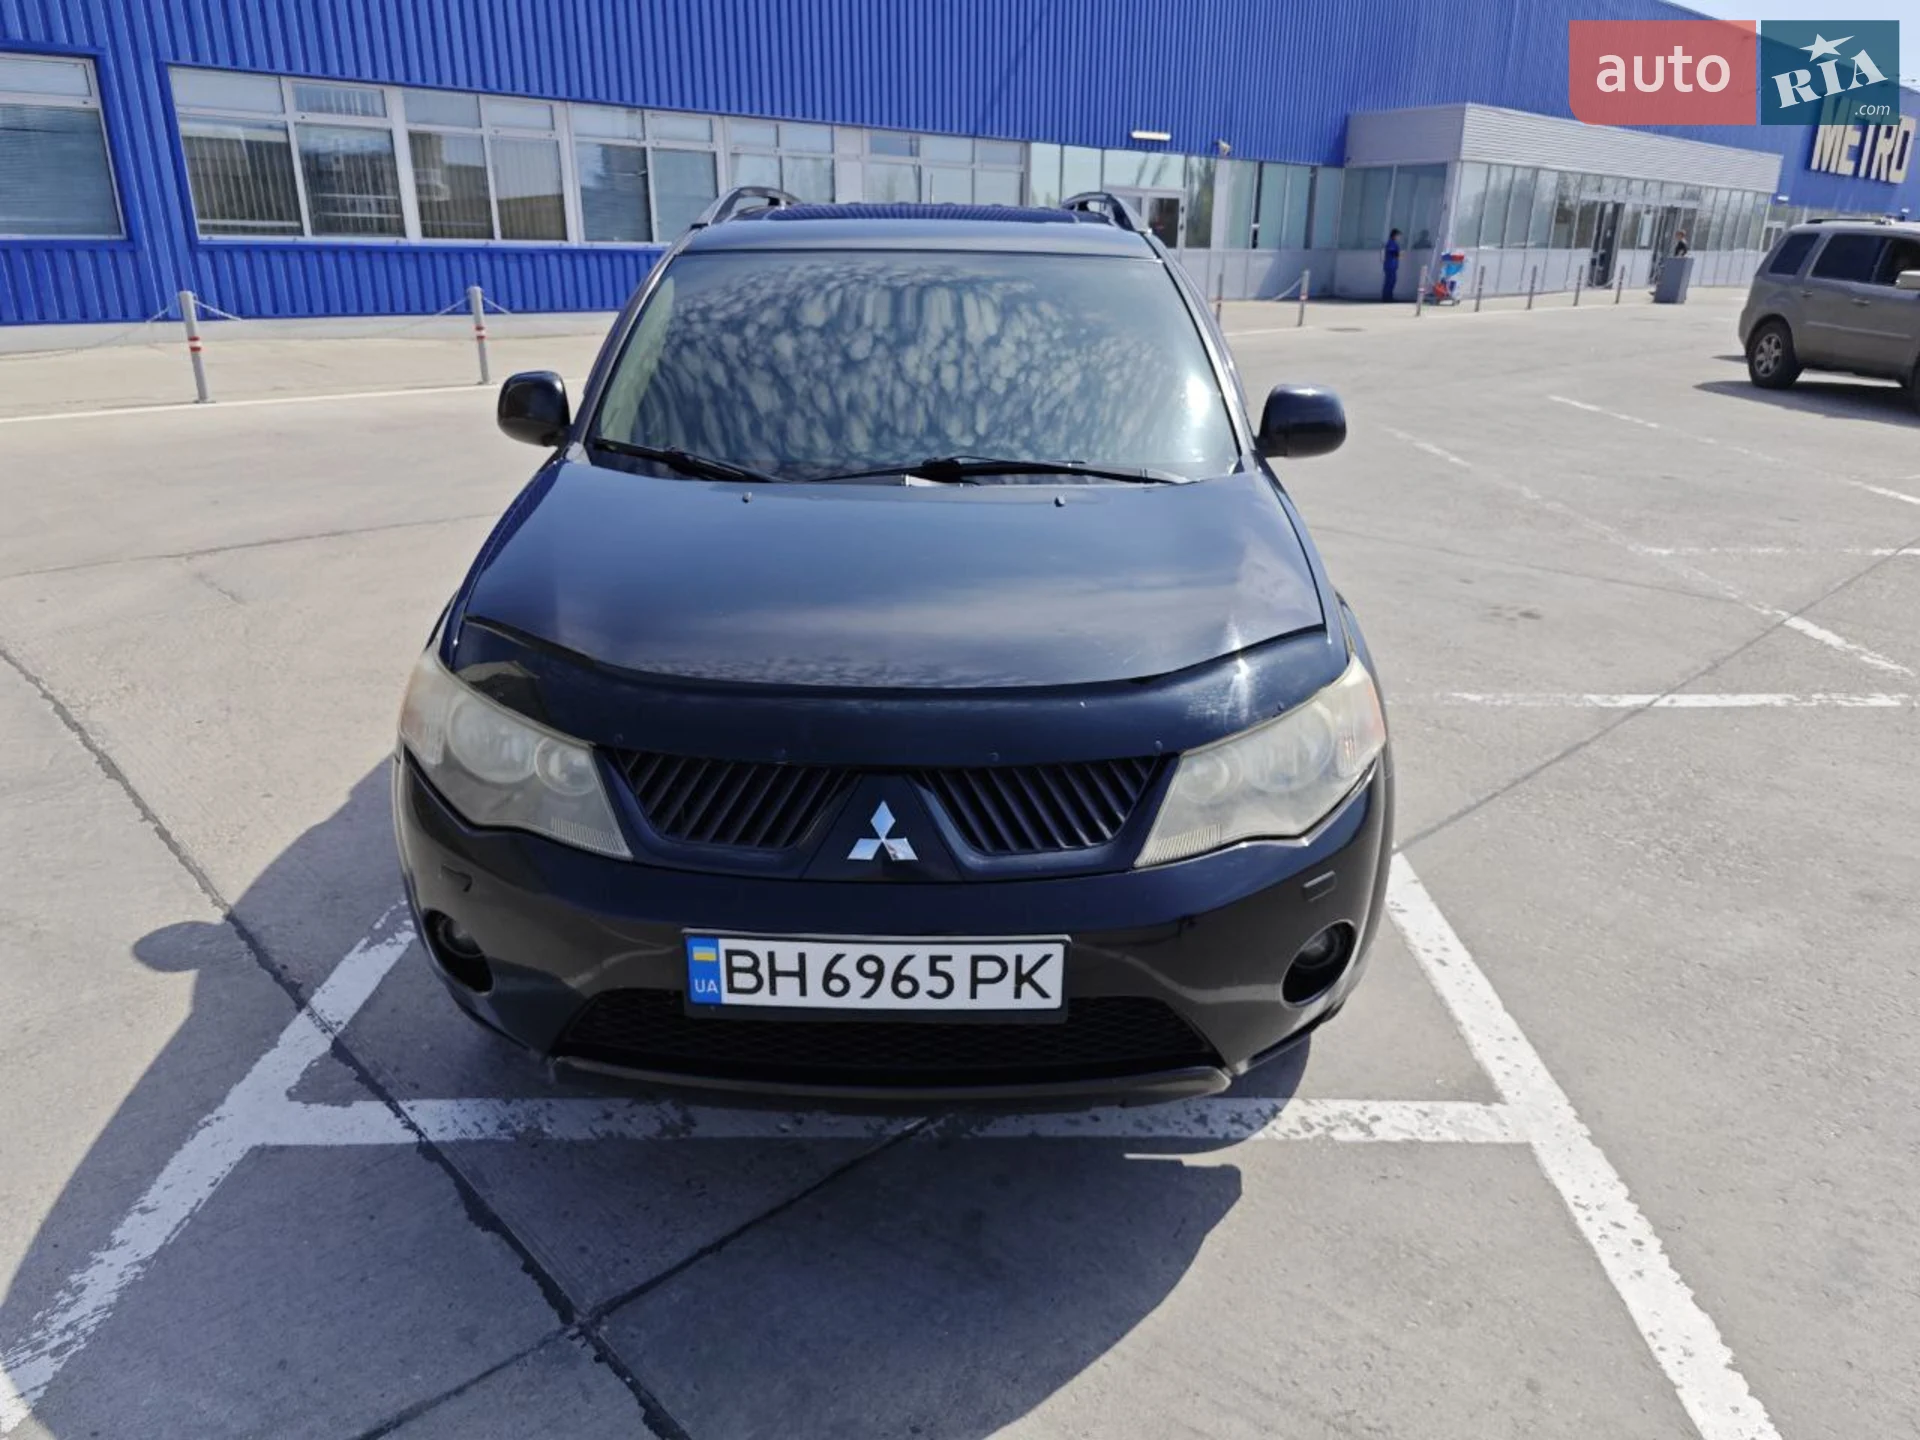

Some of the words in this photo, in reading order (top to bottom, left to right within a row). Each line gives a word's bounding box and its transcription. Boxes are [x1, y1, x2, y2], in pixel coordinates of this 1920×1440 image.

[1811, 96, 1916, 183] METRO
[694, 979, 719, 994] UA
[724, 948, 808, 997] BH
[821, 953, 955, 1000] 6965
[969, 953, 1055, 1000] PK
